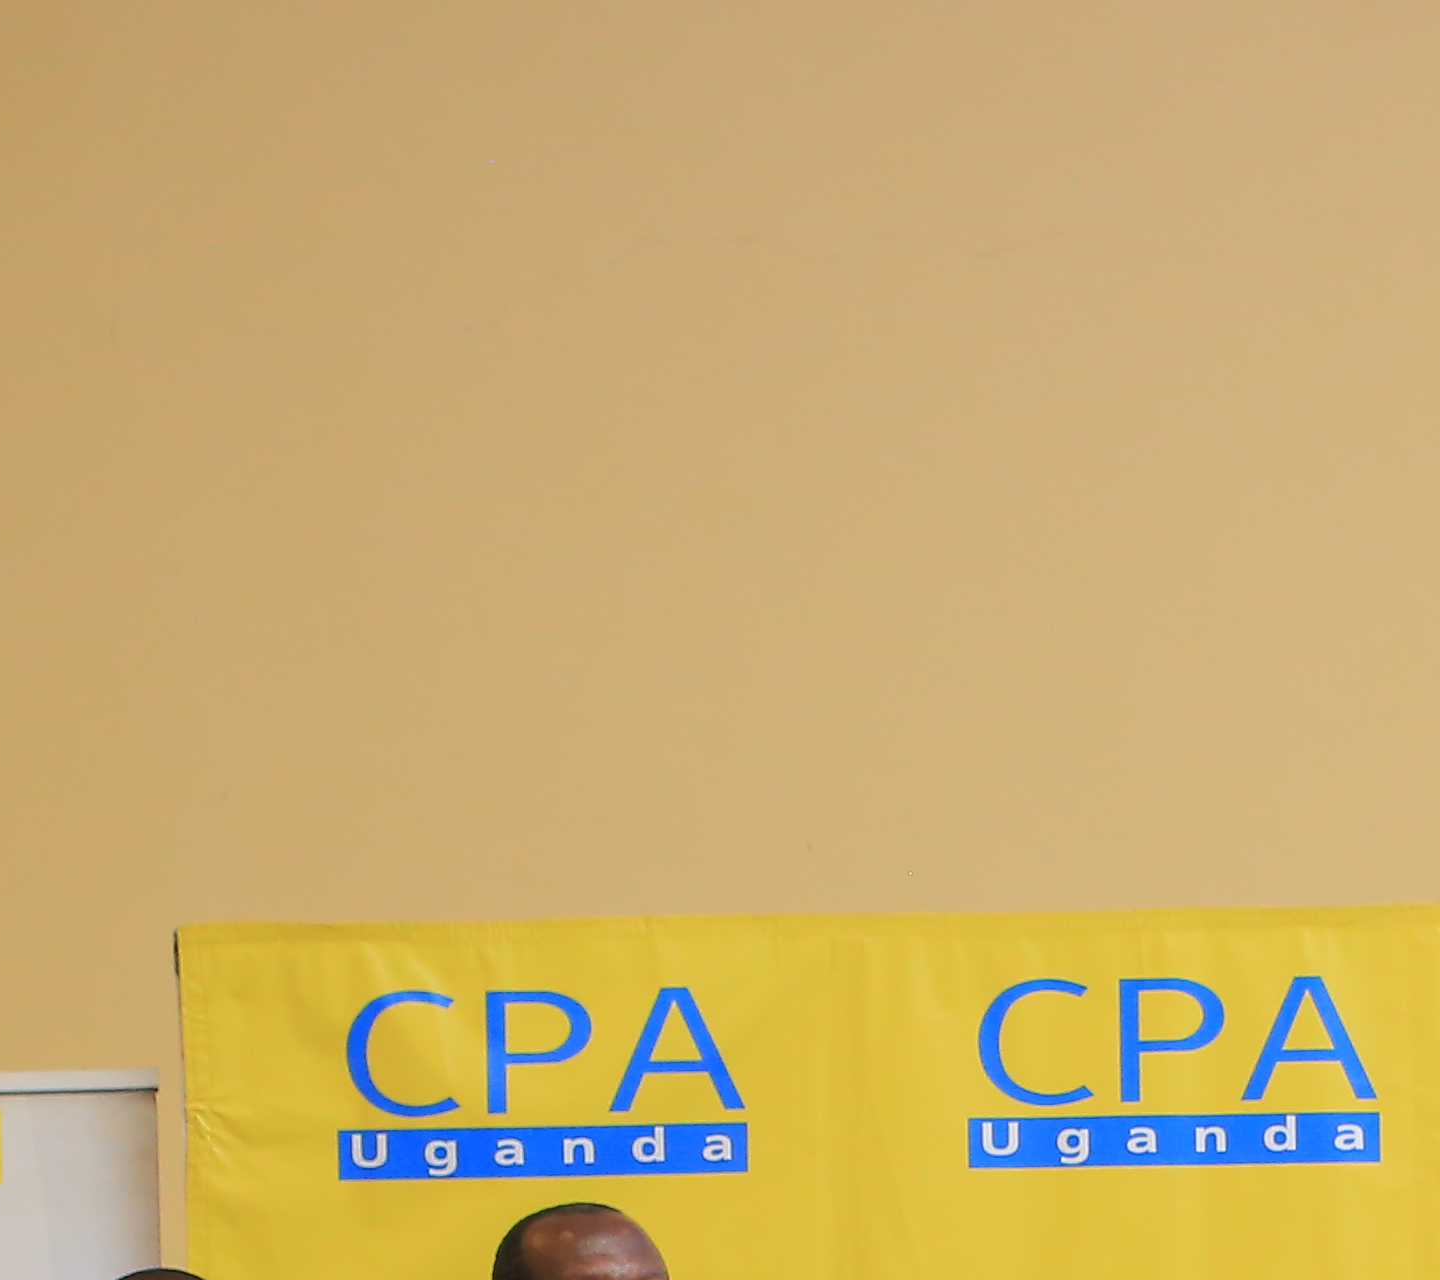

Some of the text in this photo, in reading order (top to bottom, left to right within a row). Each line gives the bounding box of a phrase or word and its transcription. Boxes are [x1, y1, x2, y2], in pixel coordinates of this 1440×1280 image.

[348, 987, 744, 1117] CPA
[979, 976, 1376, 1105] CPA
[351, 1126, 732, 1176] Uganda
[981, 1115, 1366, 1164] Uganda
